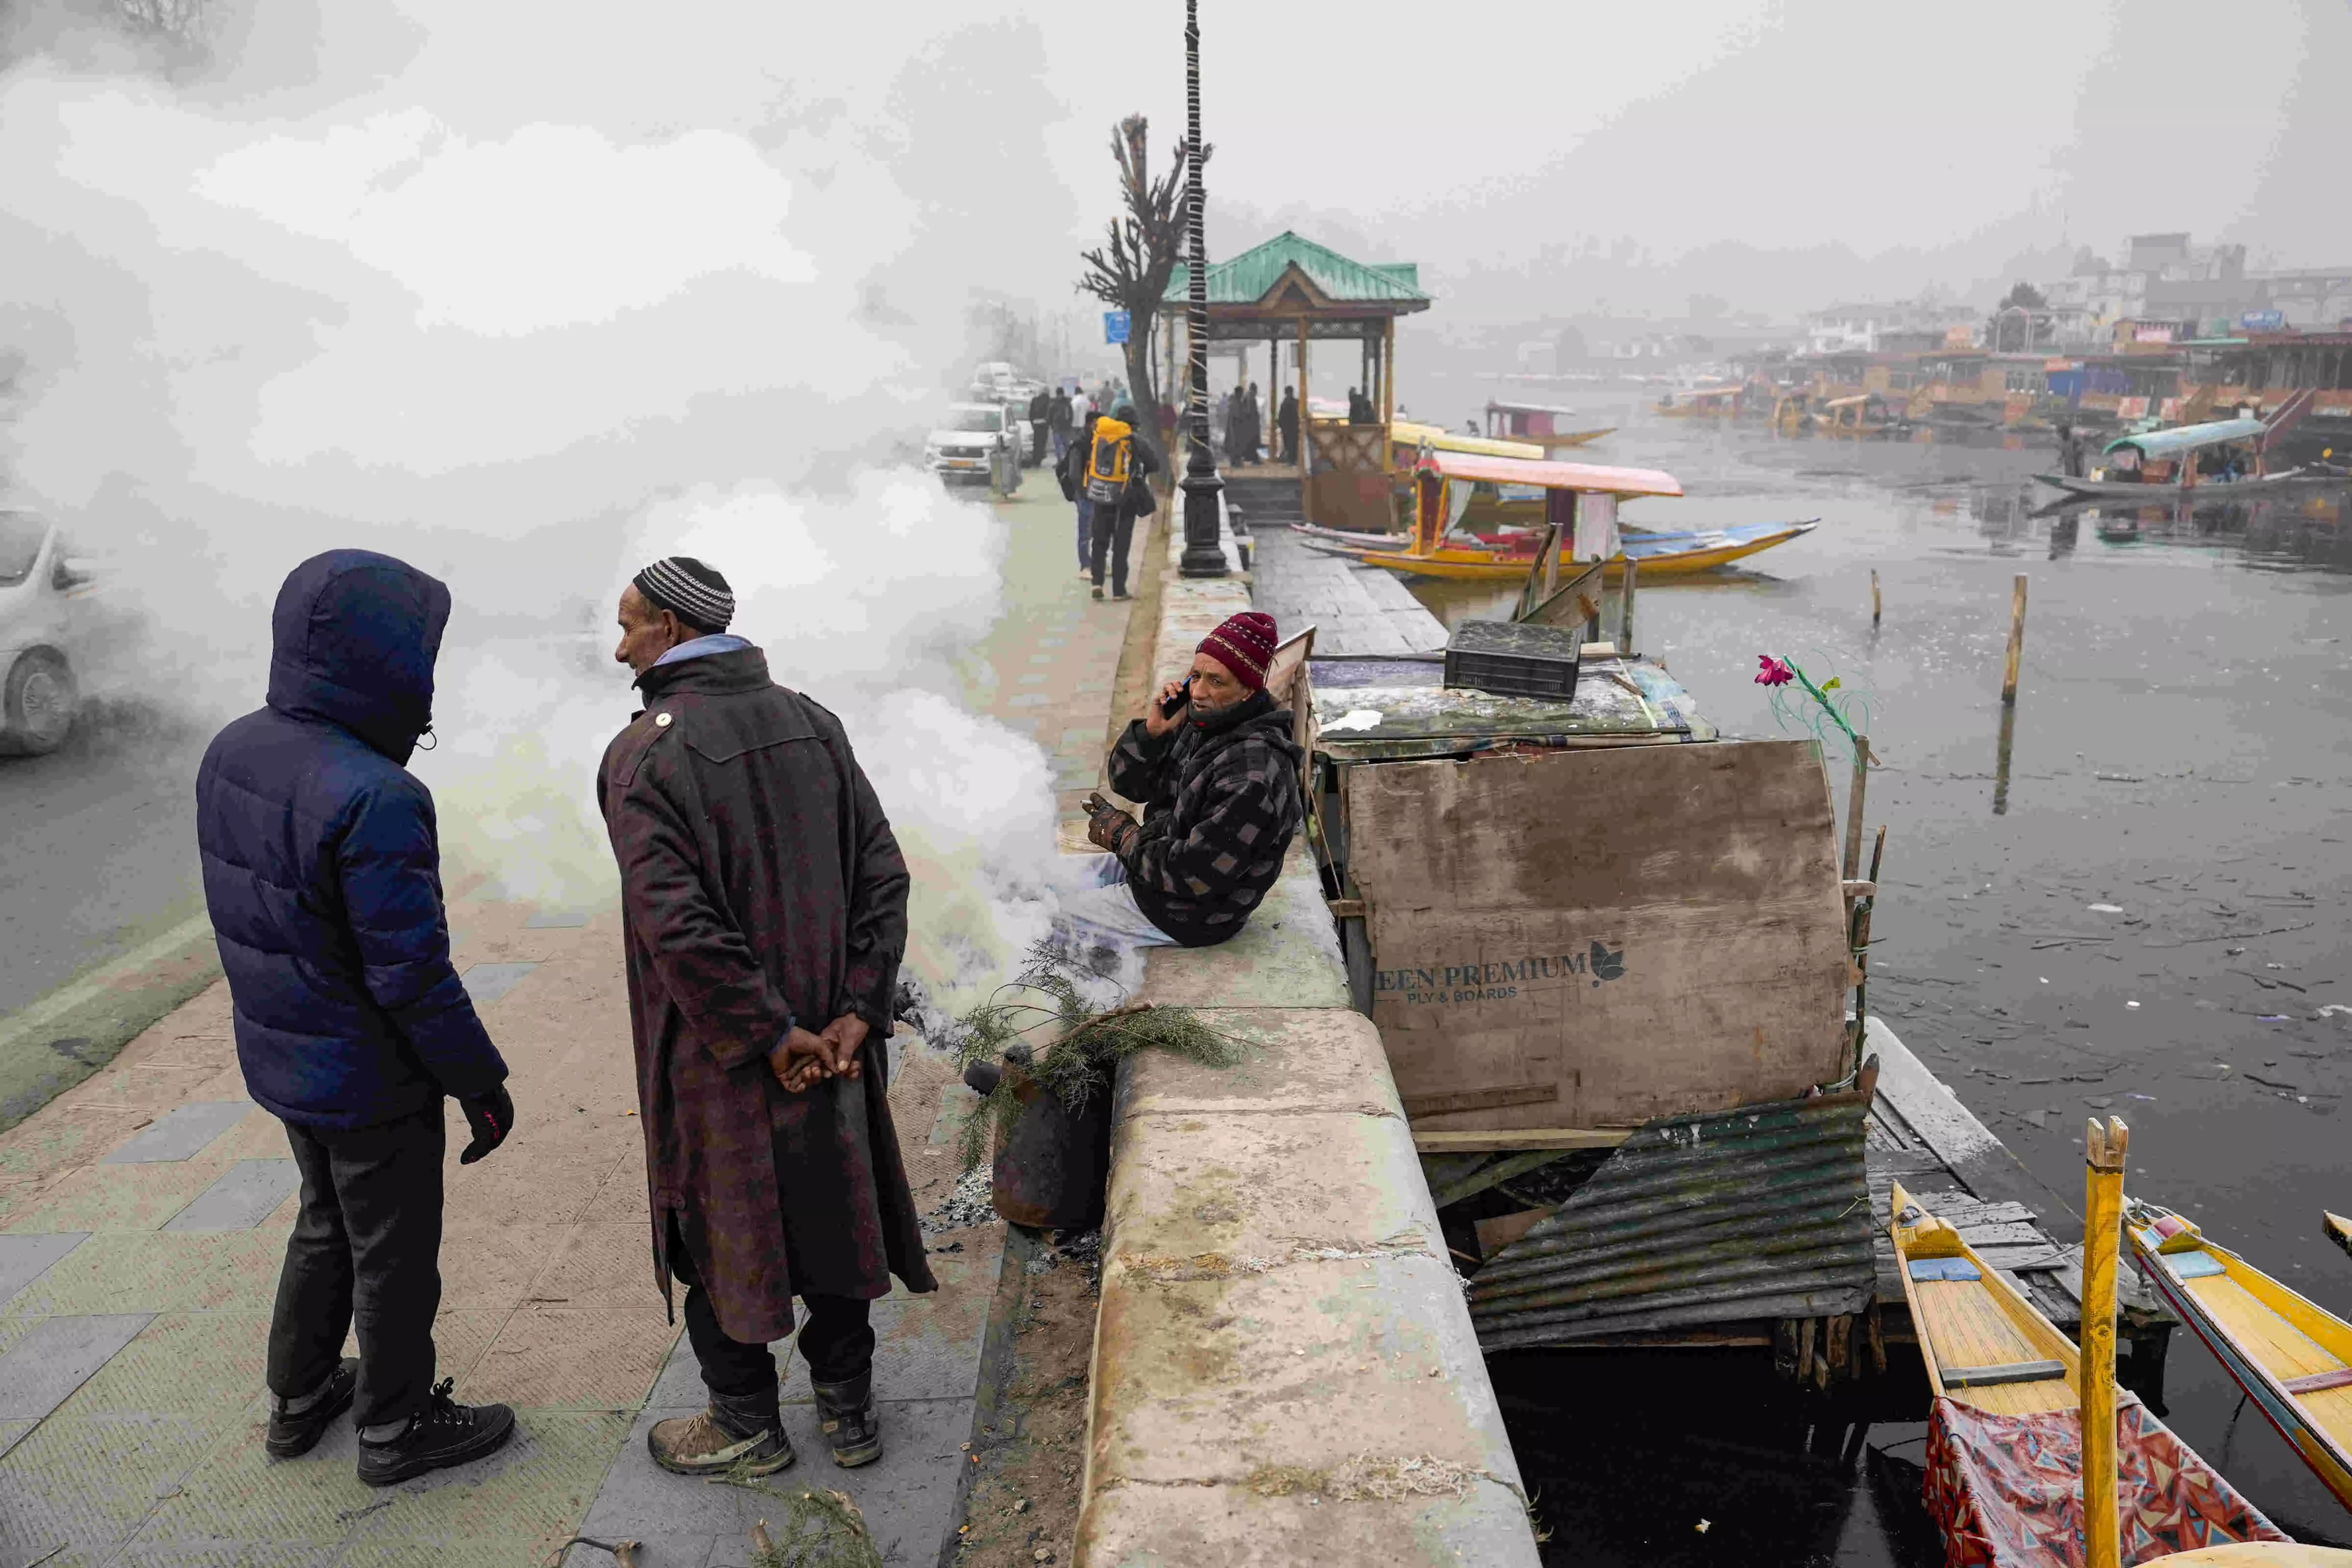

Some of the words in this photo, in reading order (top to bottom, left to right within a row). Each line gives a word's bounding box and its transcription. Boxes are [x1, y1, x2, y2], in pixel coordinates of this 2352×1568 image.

[1445, 953, 1588, 987] PREMIUM
[1407, 992, 1435, 1004] PLY
[1439, 991, 1448, 1003] &
[1454, 986, 1518, 1002] BOARDS
